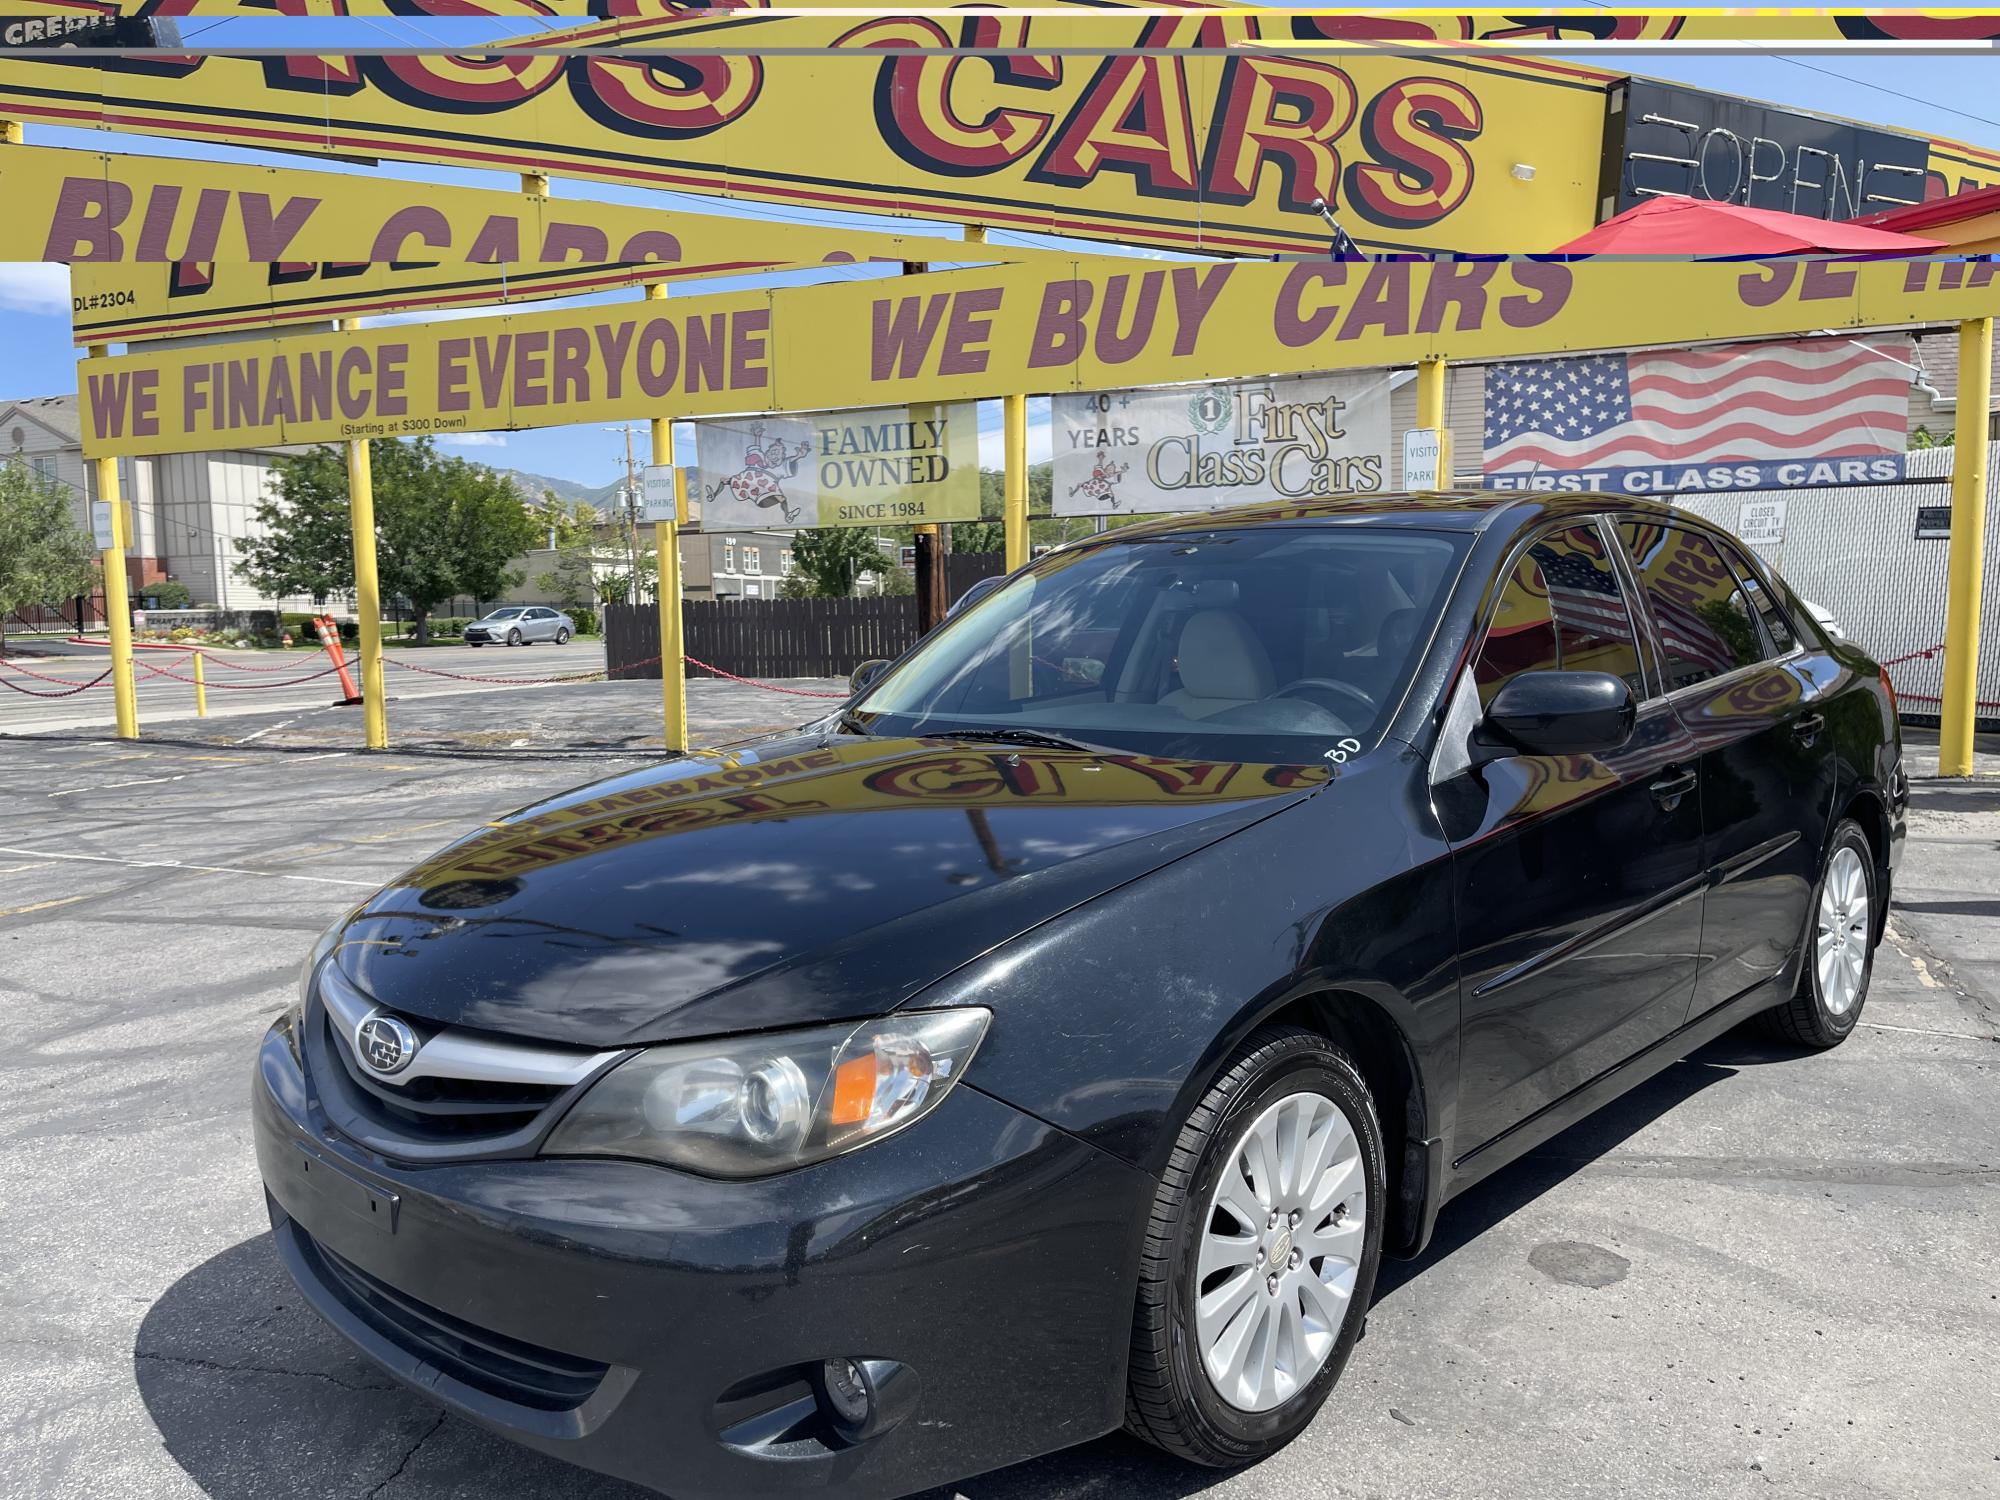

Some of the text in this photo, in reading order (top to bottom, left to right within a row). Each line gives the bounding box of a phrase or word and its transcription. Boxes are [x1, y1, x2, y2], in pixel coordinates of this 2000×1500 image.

[873, 56, 1483, 229] CARS
[1702, 127, 1866, 222] OPEN
[42, 176, 322, 261] BUY
[73, 290, 135, 312] DL#2304
[872, 287, 1004, 381] WE
[1028, 262, 1236, 369] BUY
[1274, 262, 1573, 348] CARS
[88, 308, 770, 439] WE FINANCE EVERYONE
[1086, 393, 1111, 413] 40
[340, 415, 467, 436] (Starting at $300 Down)
[819, 419, 948, 456] FAMILY
[1067, 426, 1140, 449] YEARS
[1233, 387, 1346, 462] First
[1146, 434, 1382, 497] Class Cars
[1410, 446, 1438, 457] VISITO
[820, 454, 949, 489] OWNED
[1407, 470, 1434, 482] PARKI
[1493, 460, 1899, 492] FIRST CLASS CARS
[839, 501, 926, 520] SINCE 1984
[1324, 738, 1361, 763] BD
